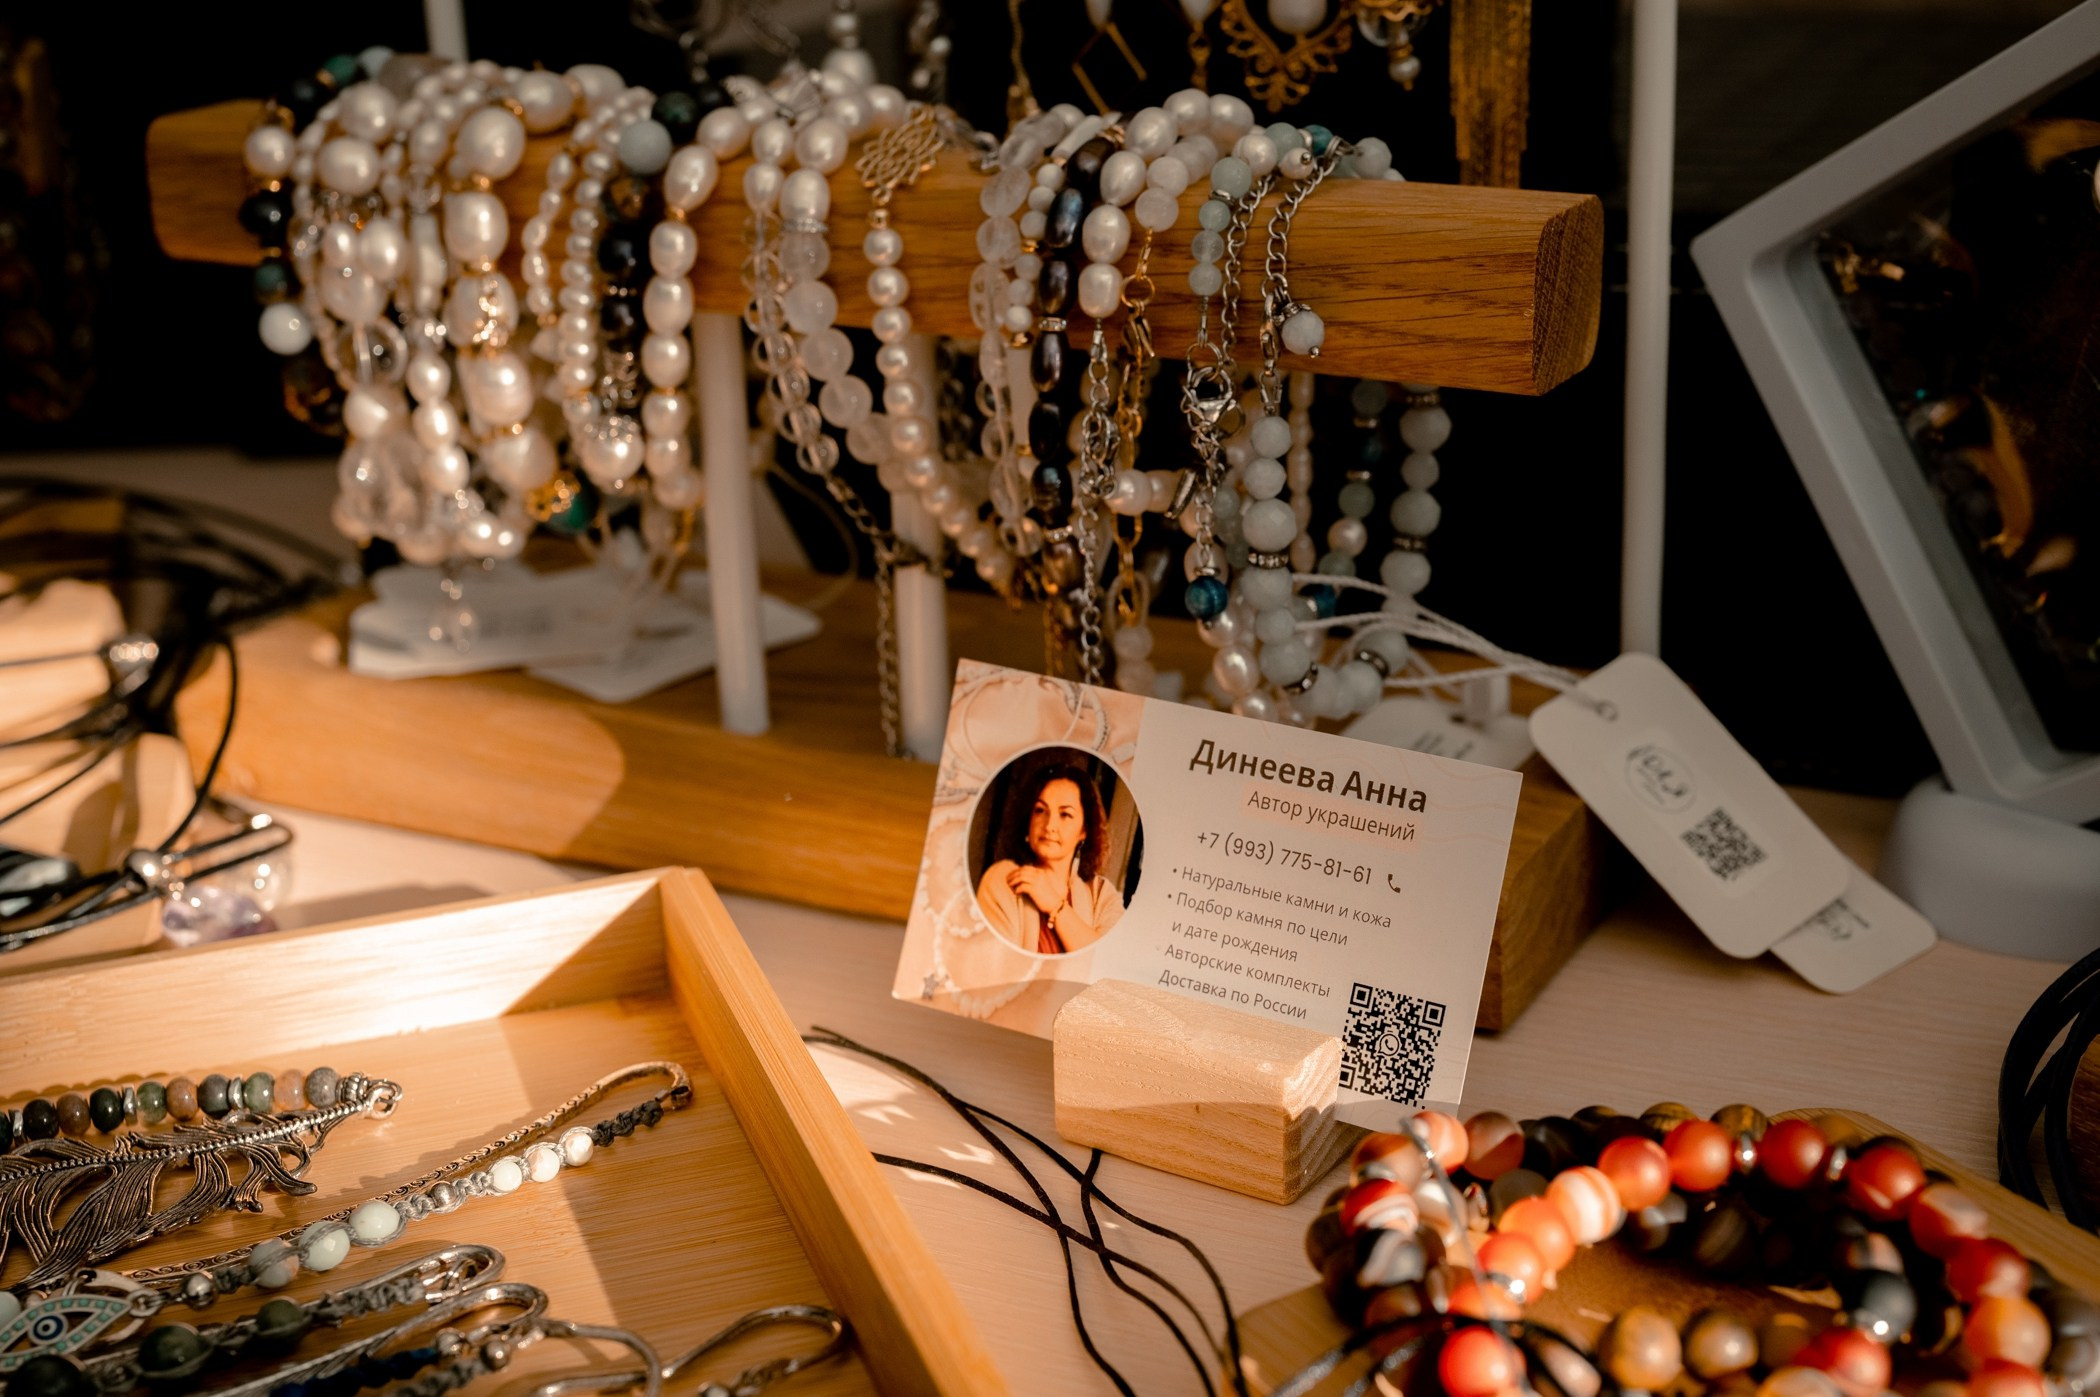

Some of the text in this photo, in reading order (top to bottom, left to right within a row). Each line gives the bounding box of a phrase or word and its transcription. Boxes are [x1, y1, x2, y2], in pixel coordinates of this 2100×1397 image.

[1189, 739, 1427, 812] Динеева Анна
[1247, 791, 1415, 841] Автор украшений
[1197, 831, 1372, 885] +7 (993) 775-81-61
[1176, 891, 1348, 949] Подбор камня по цели
[1182, 866, 1391, 928] Натуральные камни и кожа
[1172, 920, 1298, 962] и дате рождения
[1158, 969, 1307, 1019] Доставка по России
[1165, 944, 1331, 998] Авторские комплекты
